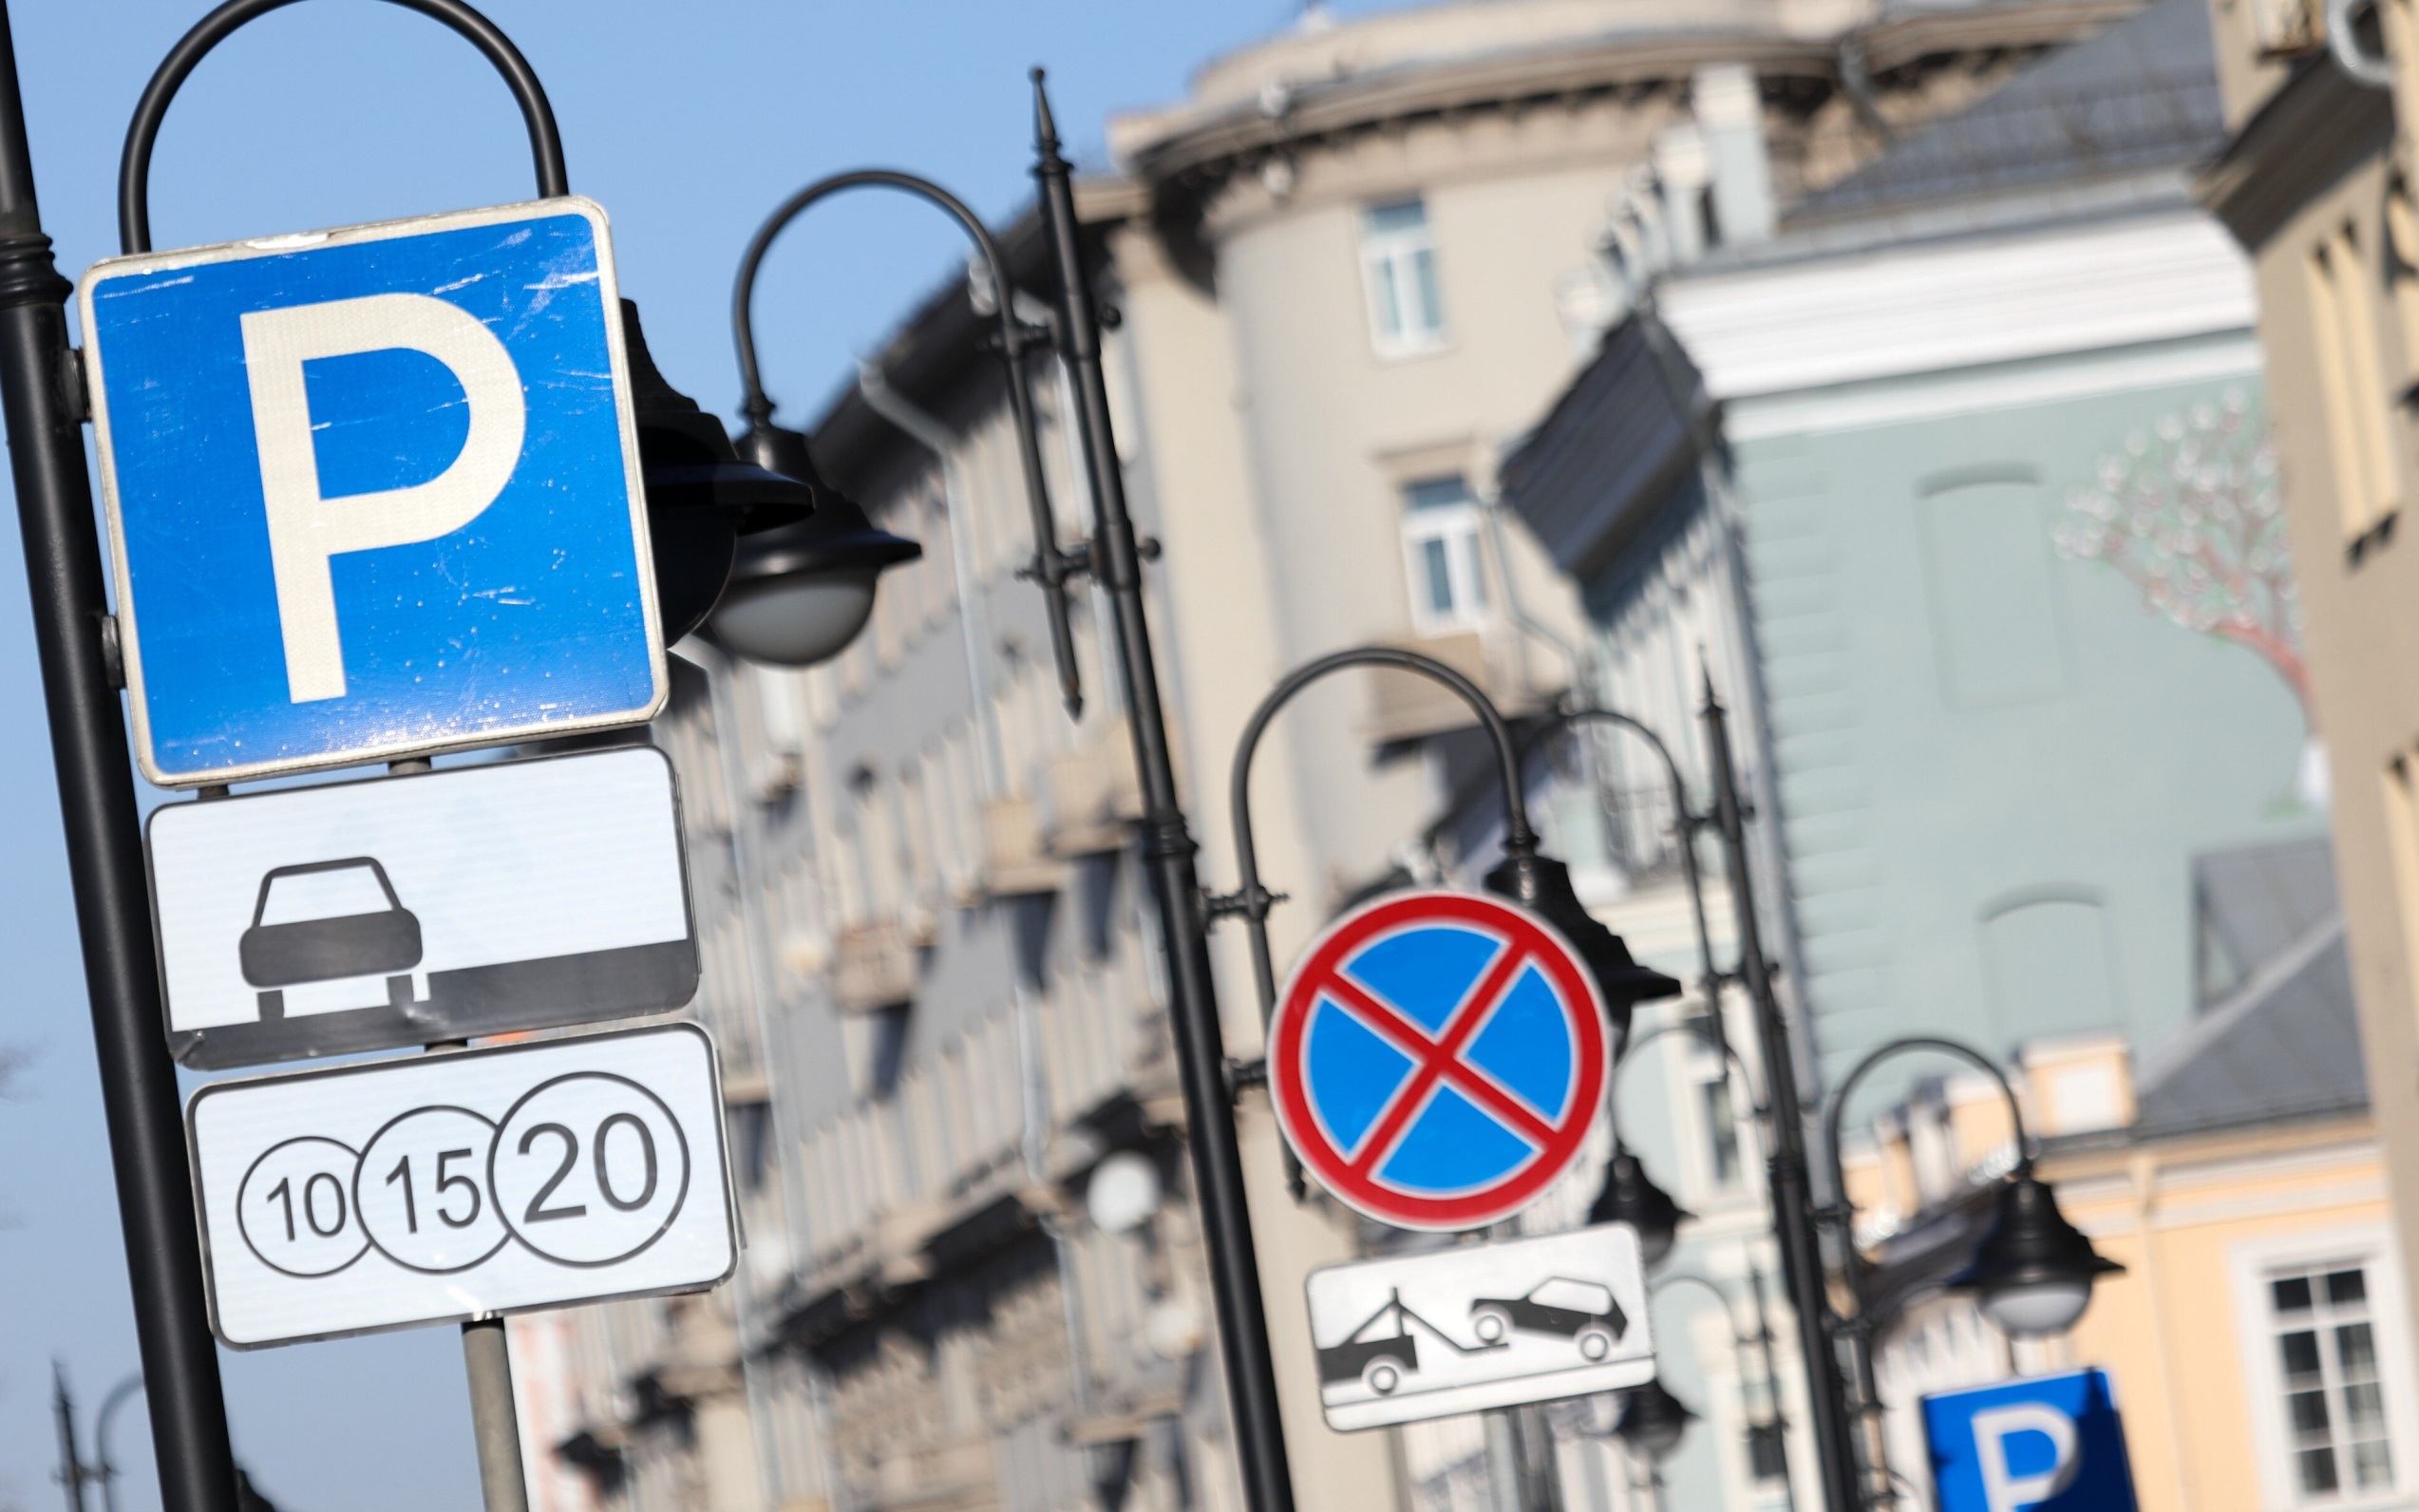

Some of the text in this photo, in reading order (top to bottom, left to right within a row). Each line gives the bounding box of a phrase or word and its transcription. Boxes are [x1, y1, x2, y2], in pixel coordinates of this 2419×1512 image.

[240, 293, 526, 704] P
[266, 1113, 658, 1242] 10 15 20
[1972, 1402, 2080, 1512] P
